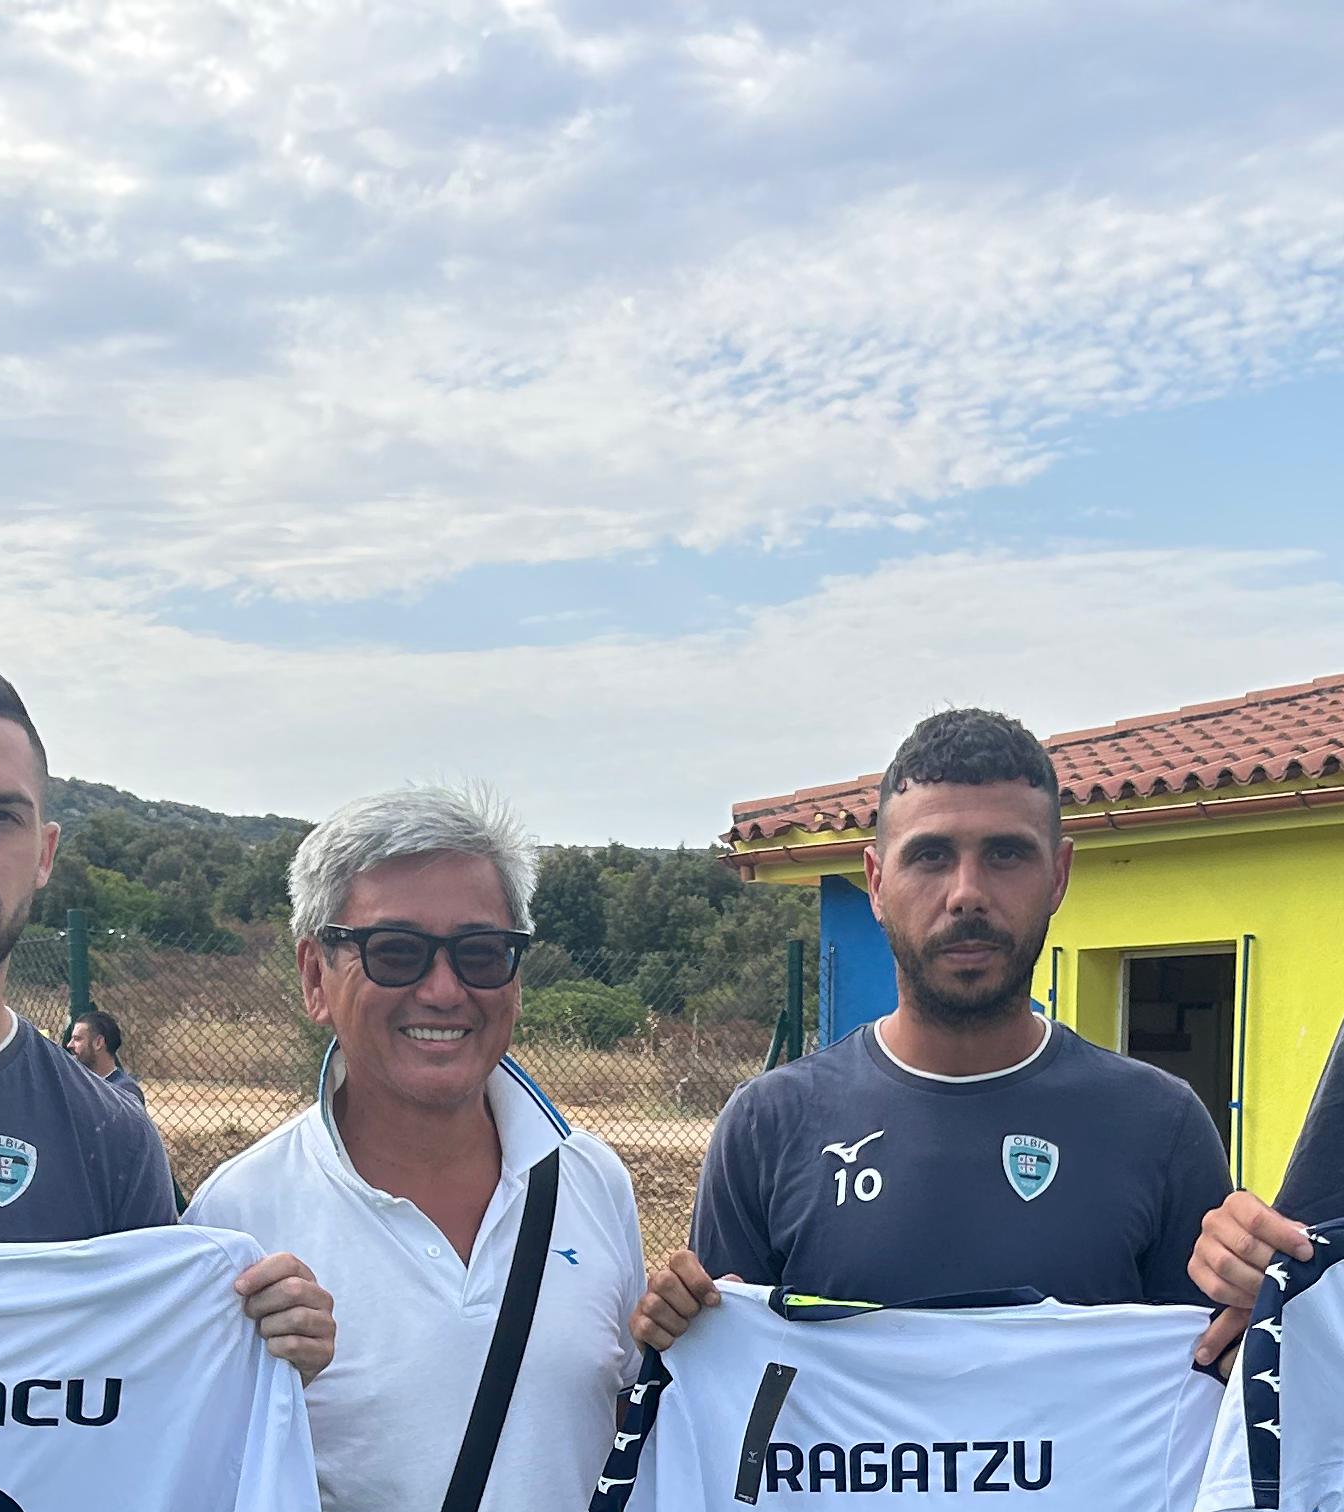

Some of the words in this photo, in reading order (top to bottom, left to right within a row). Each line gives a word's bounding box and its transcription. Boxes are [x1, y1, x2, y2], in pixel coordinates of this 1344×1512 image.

[1013, 1136, 1049, 1152] OLBIA
[834, 1167, 883, 1206] 10
[765, 1439, 1054, 1493] RAGATZU
